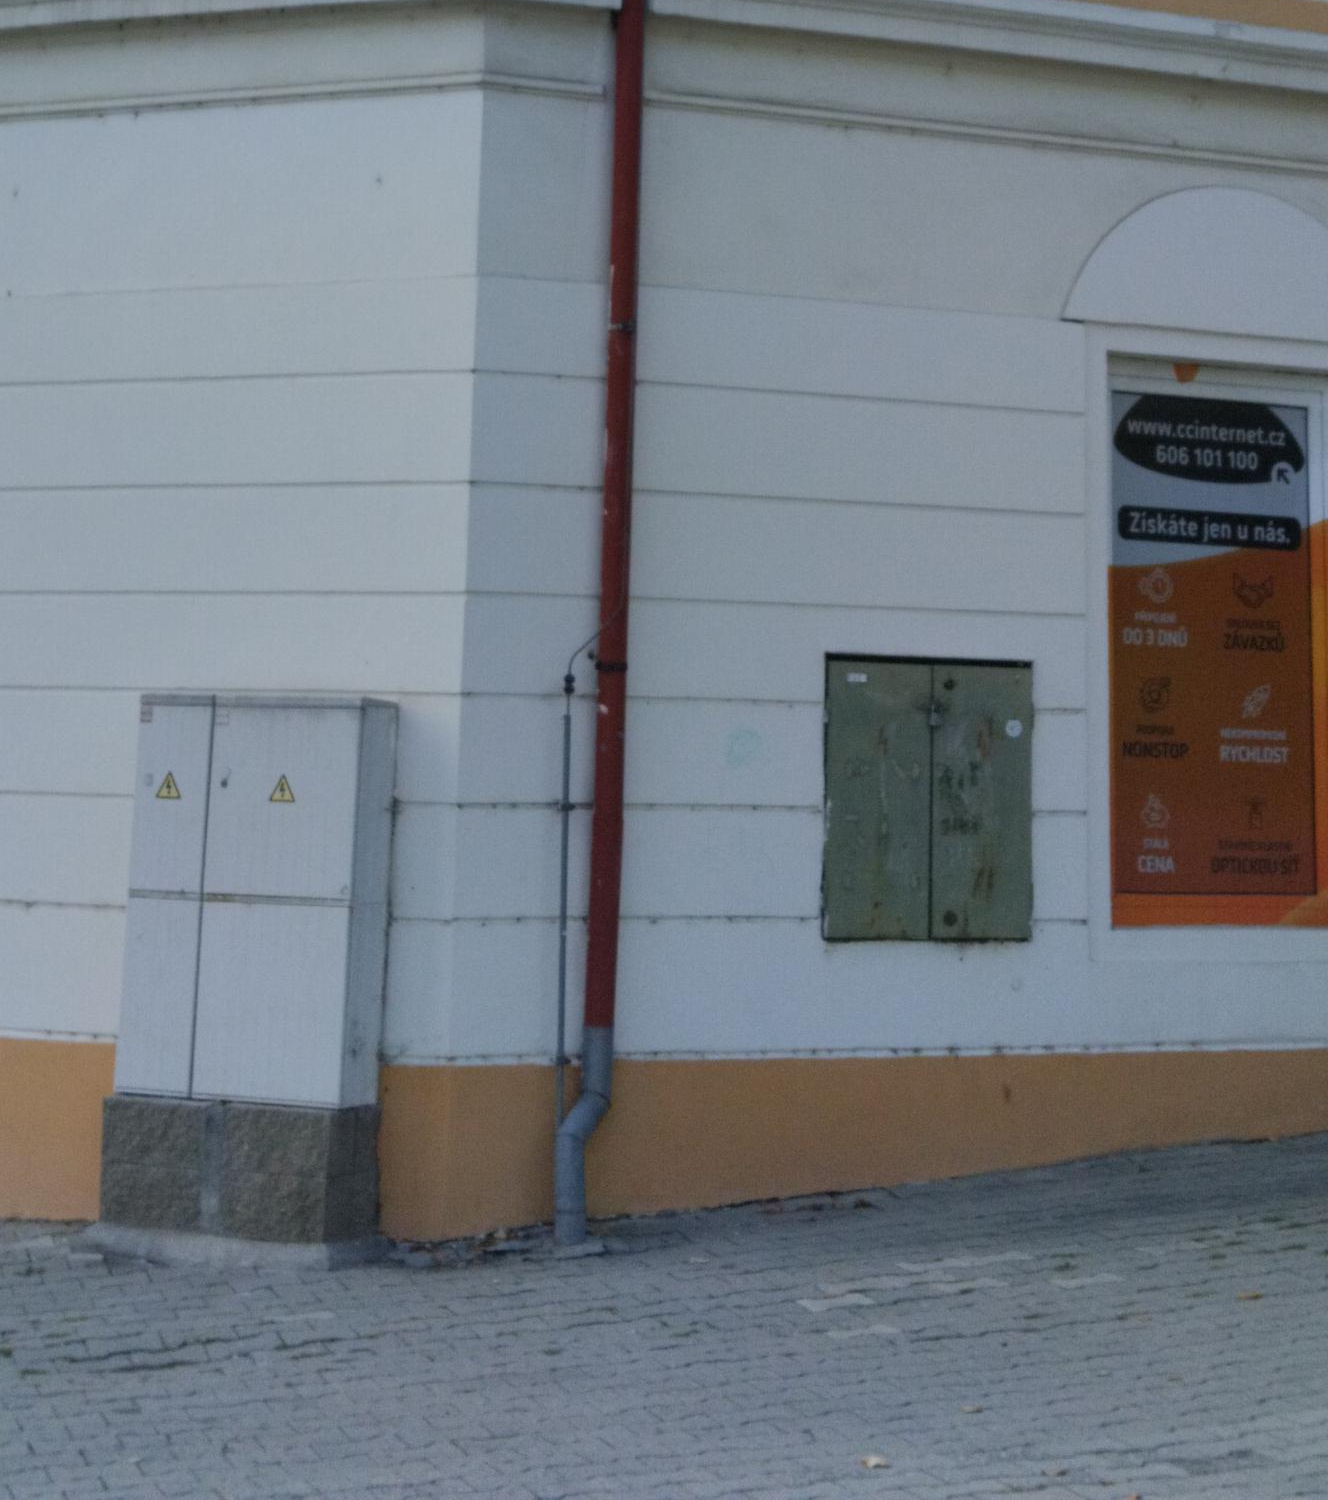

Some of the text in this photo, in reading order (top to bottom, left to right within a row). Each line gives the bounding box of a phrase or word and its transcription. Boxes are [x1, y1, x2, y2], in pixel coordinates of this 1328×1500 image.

[1127, 419, 1287, 446] www.ccinternet.cz
[1156, 445, 1259, 470] 606 101 100
[1129, 511, 1291, 544] Získáte jen u nás.
[1122, 740, 1190, 758] NONSTOP
